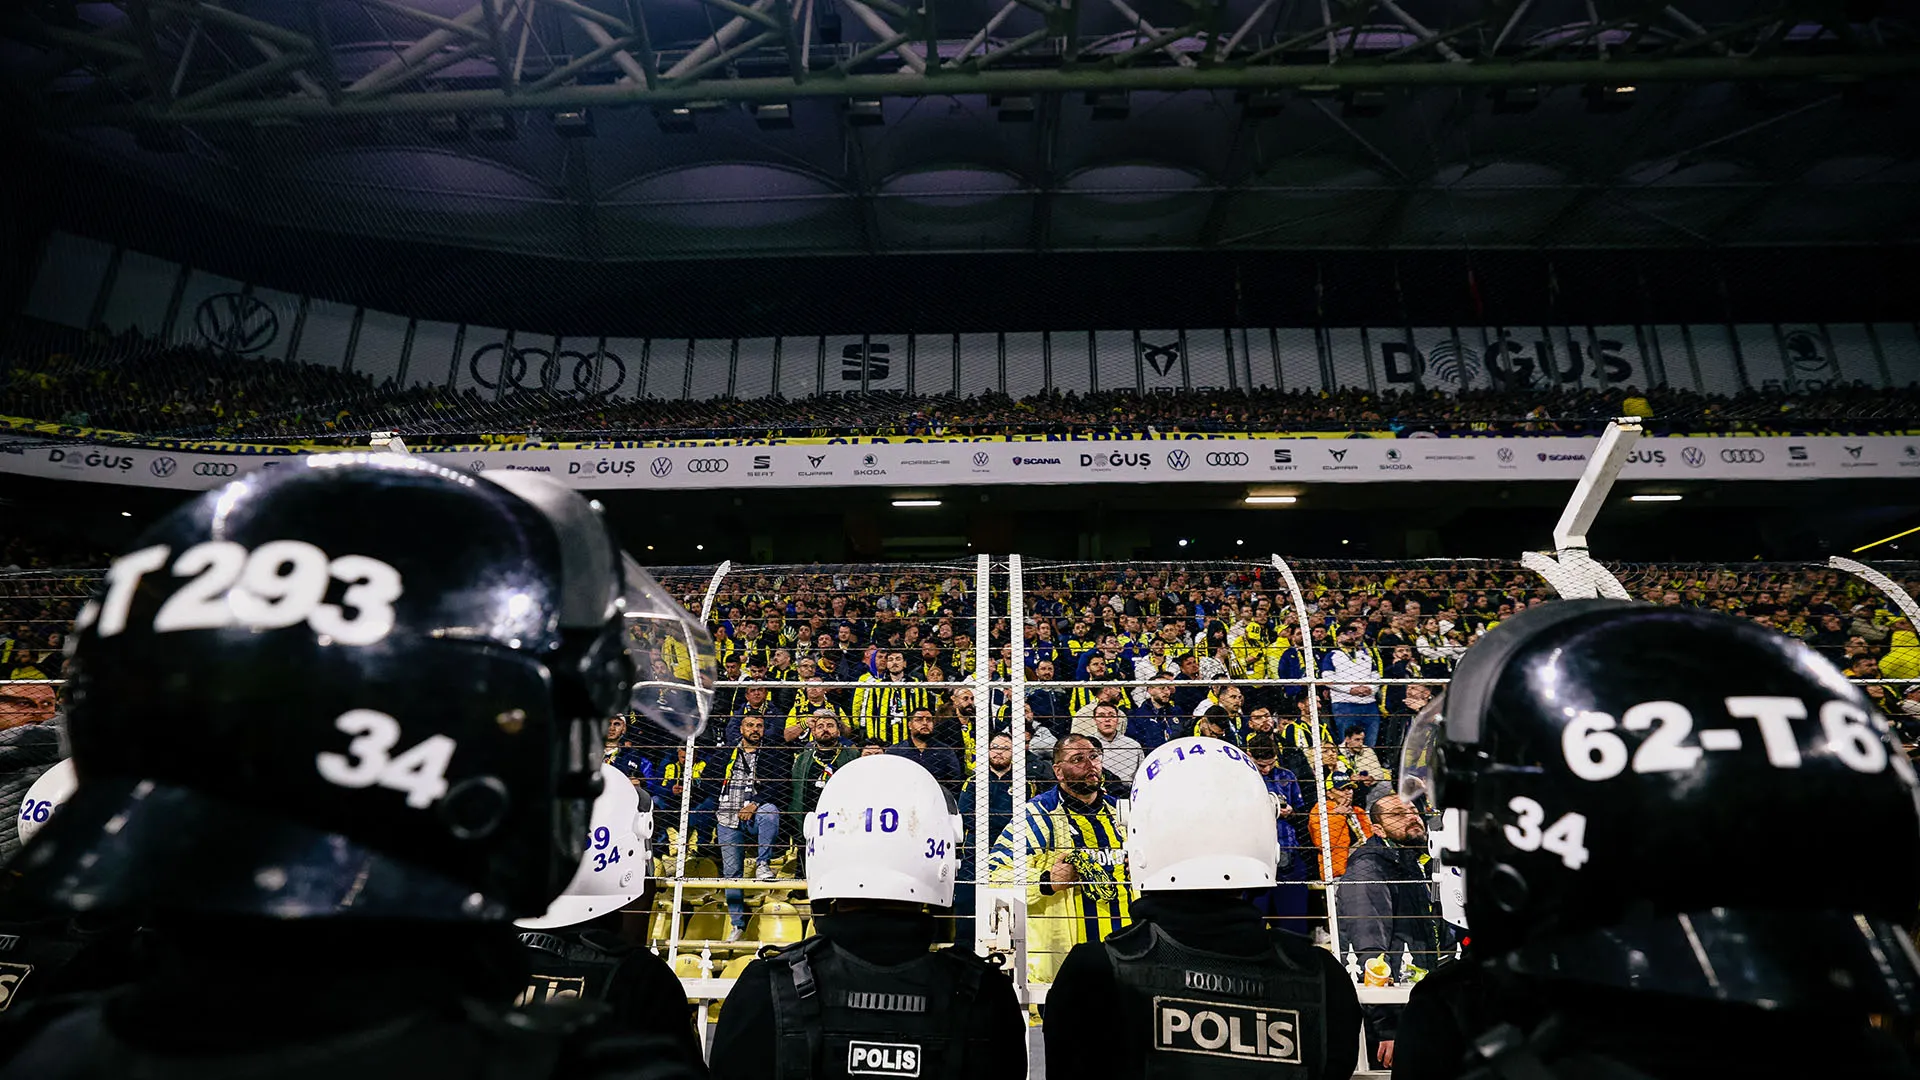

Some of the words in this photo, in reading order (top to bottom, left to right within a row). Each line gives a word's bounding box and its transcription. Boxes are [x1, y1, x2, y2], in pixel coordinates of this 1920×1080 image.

[568, 458, 635, 477] DOĞUŞ
[1023, 457, 1061, 465] SCANIA
[1080, 450, 1151, 470] DOĞUŞ
[316, 708, 457, 809] 34
[1503, 796, 1589, 870] 34
[593, 846, 620, 872] 34
[925, 838, 945, 859] 34
